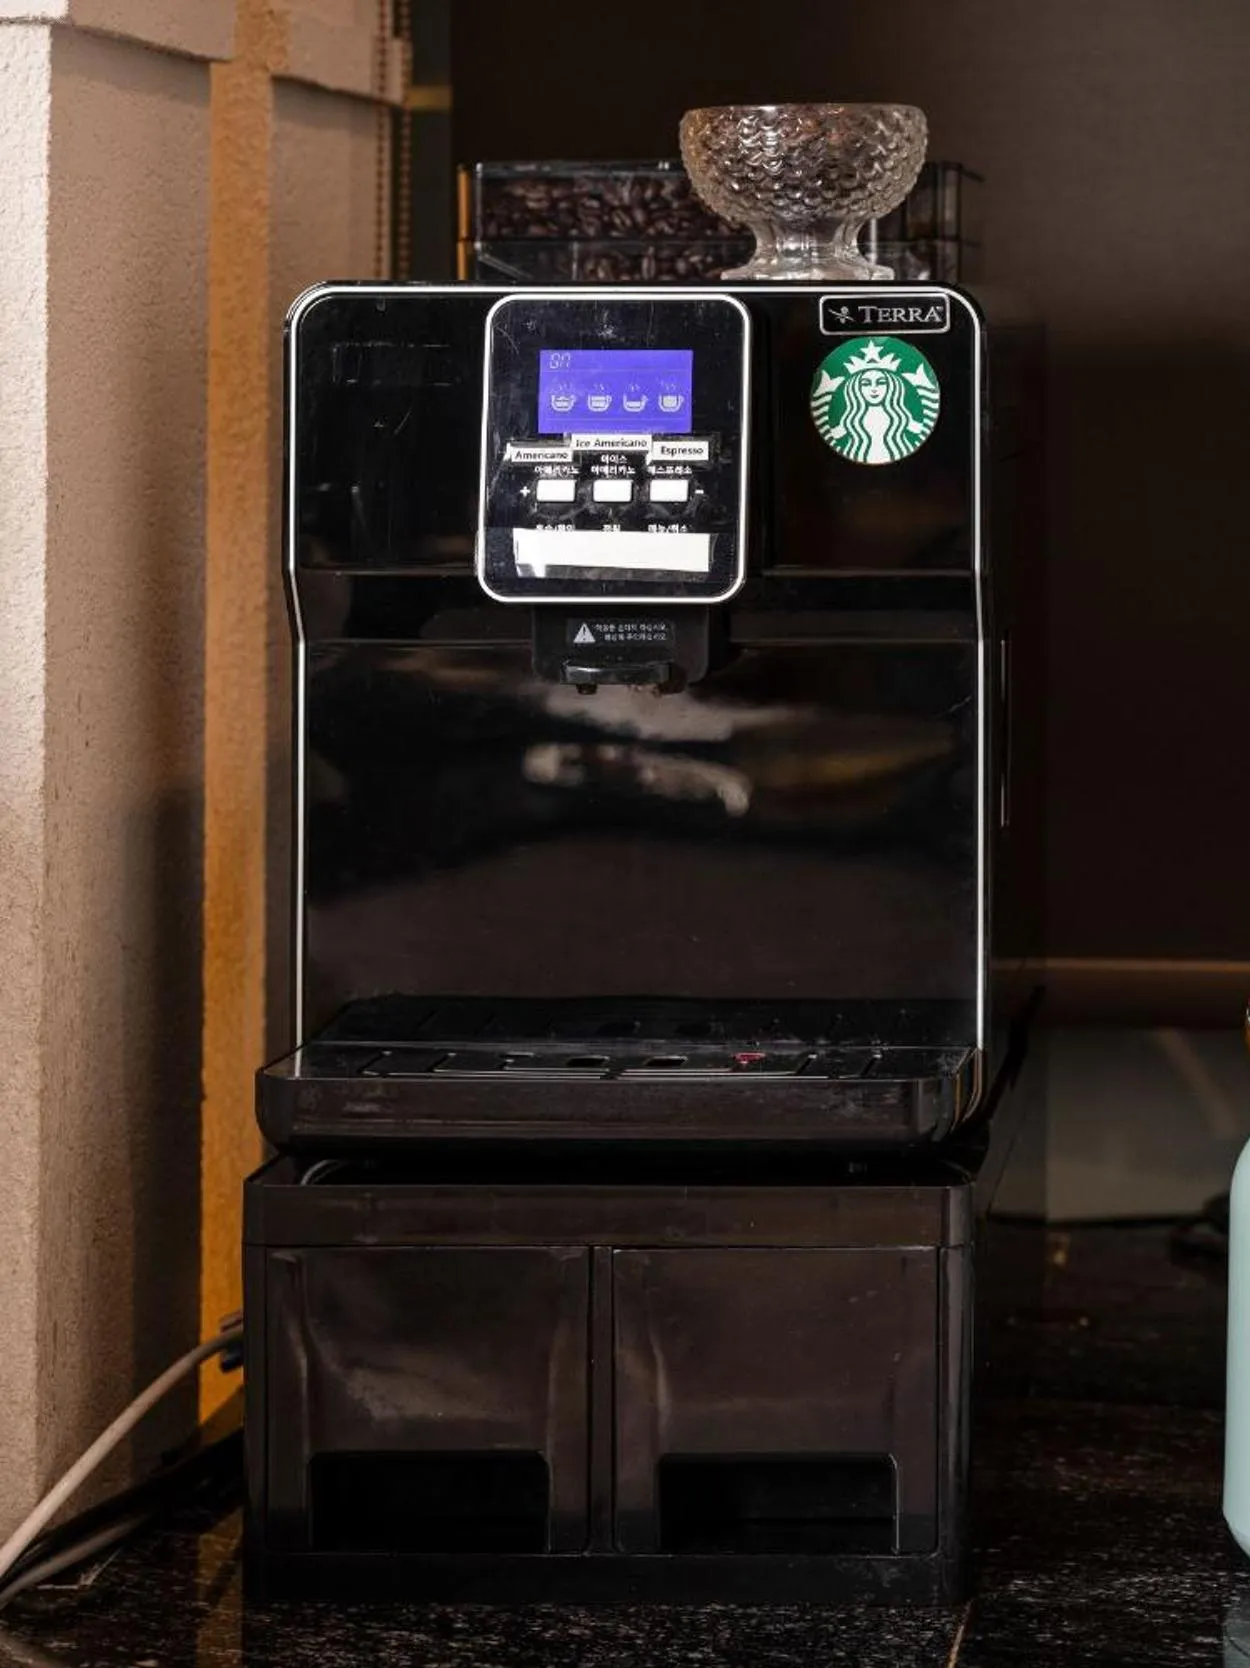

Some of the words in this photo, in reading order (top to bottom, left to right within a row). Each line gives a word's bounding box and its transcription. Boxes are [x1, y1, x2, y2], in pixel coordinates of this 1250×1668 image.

[857, 305, 942, 323] TERRA
[575, 438, 591, 448] Ice
[594, 438, 648, 449] Americano
[514, 451, 569, 461] Americano
[660, 445, 704, 456] Espresso
